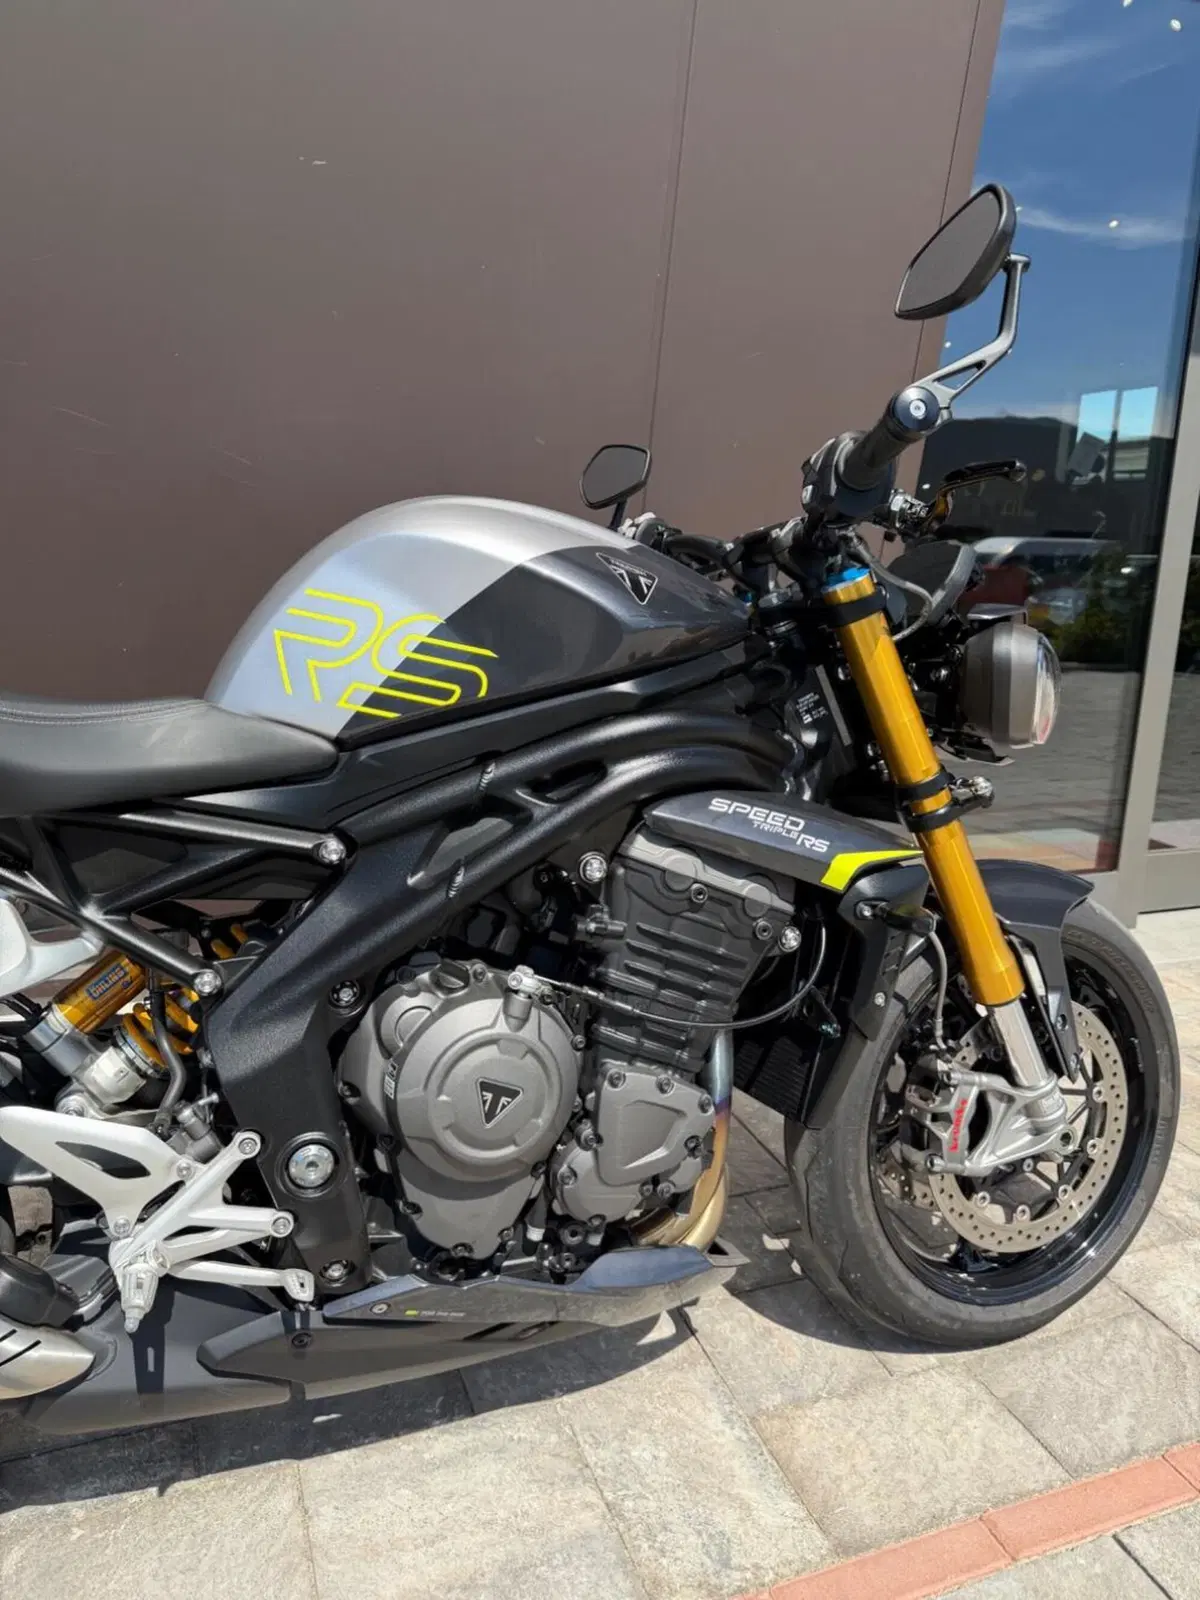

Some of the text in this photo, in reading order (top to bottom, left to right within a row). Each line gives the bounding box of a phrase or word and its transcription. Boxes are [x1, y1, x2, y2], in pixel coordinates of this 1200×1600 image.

[274, 587, 498, 718] RS
[708, 797, 806, 832] SPEED
[752, 820, 800, 840] TRIPLE
[796, 833, 830, 853] RS
